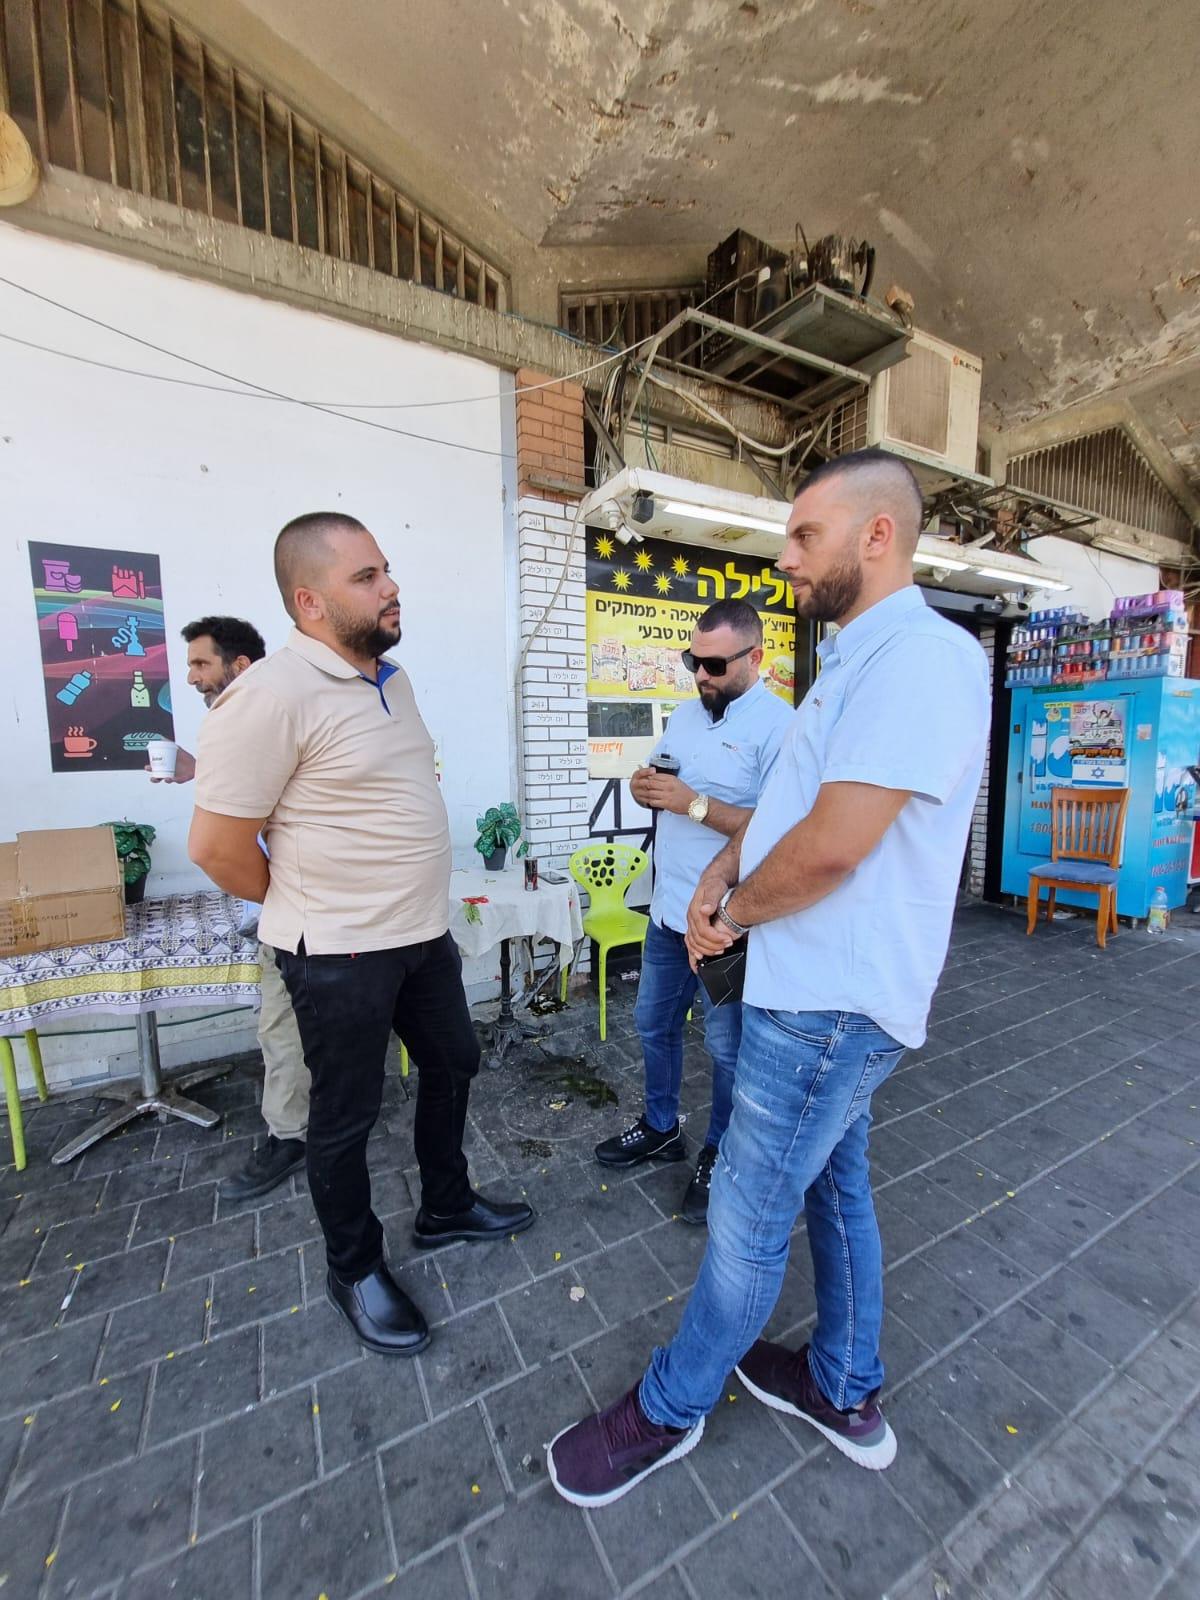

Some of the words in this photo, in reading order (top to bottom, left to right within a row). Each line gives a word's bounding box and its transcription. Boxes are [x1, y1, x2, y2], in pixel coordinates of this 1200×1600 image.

[595, 598, 657, 618] ממתקים
[670, 608, 703, 622] אפה
[638, 624, 675, 640] טבעי
[676, 628, 694, 642] וט
